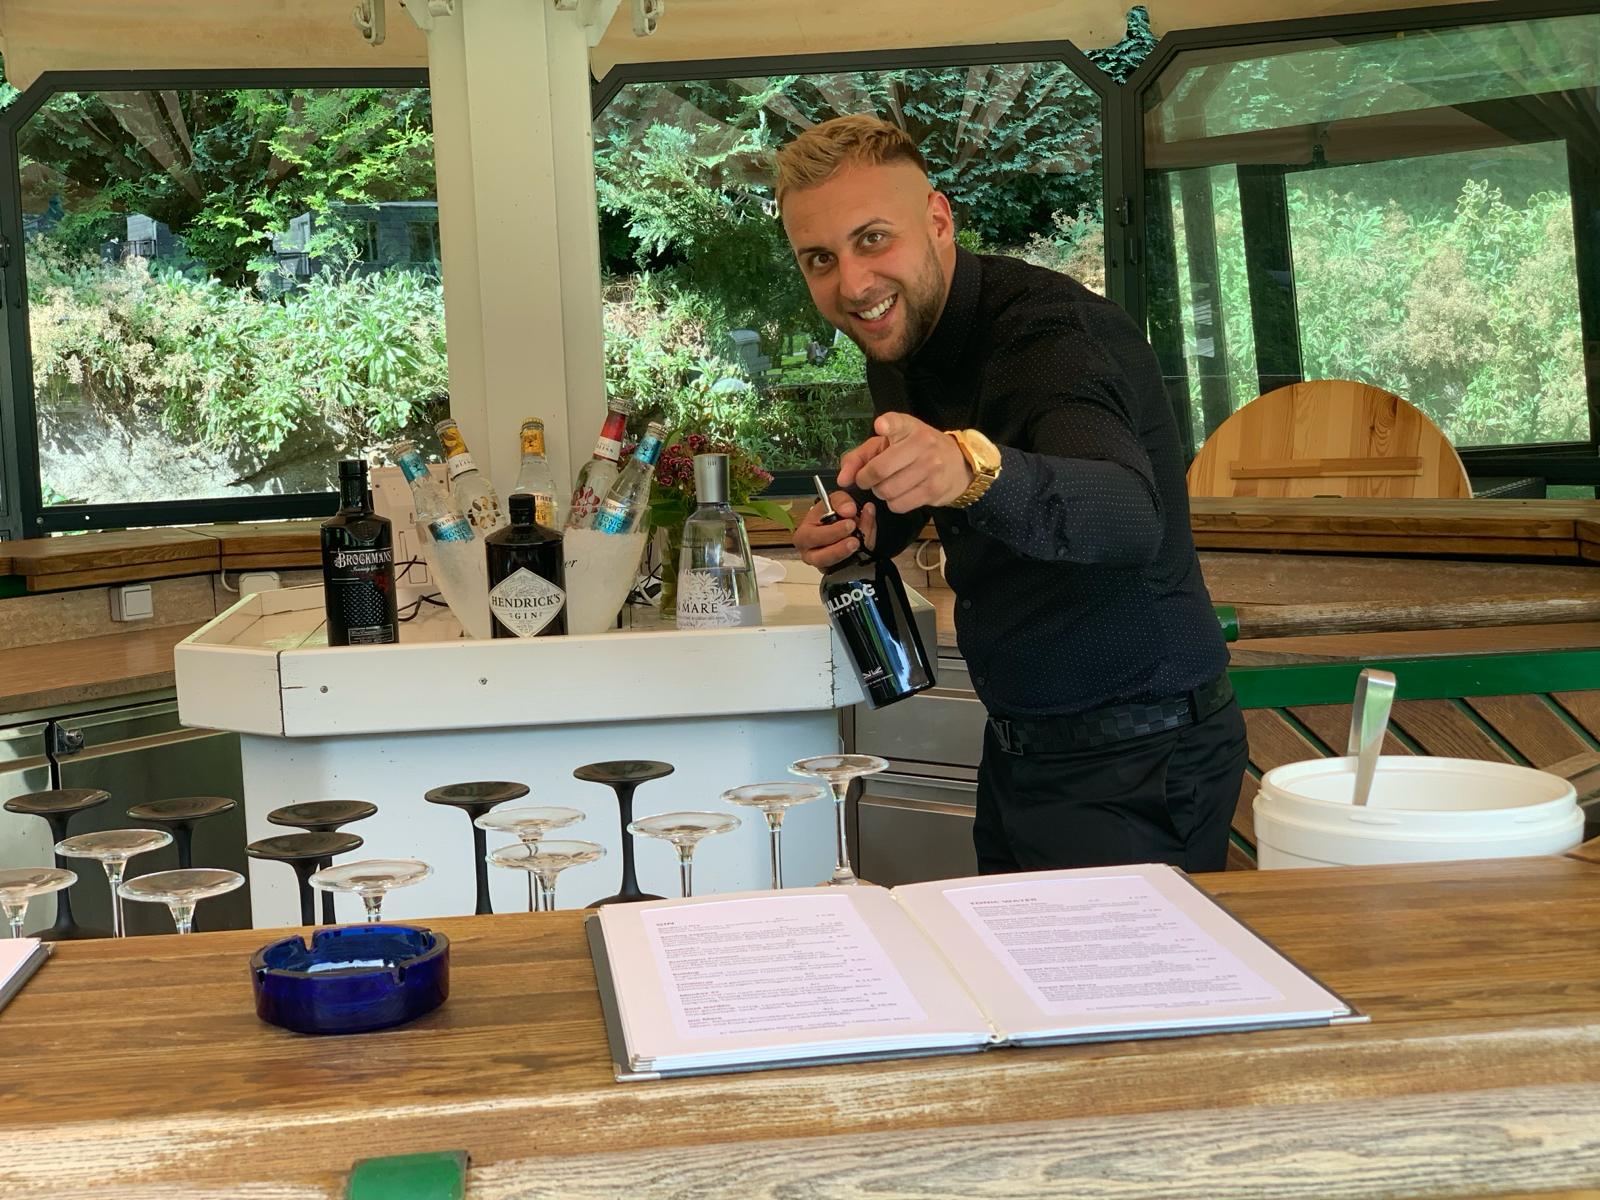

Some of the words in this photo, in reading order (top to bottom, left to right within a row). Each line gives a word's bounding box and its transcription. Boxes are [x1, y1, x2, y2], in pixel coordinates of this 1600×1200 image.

[336, 550, 392, 569] BROCKMANS
[564, 559, 578, 569] er
[491, 593, 561, 608] HENDRICK'S
[825, 583, 876, 614] ULLDOG
[682, 602, 719, 614] MARE
[514, 612, 537, 620] GIN
